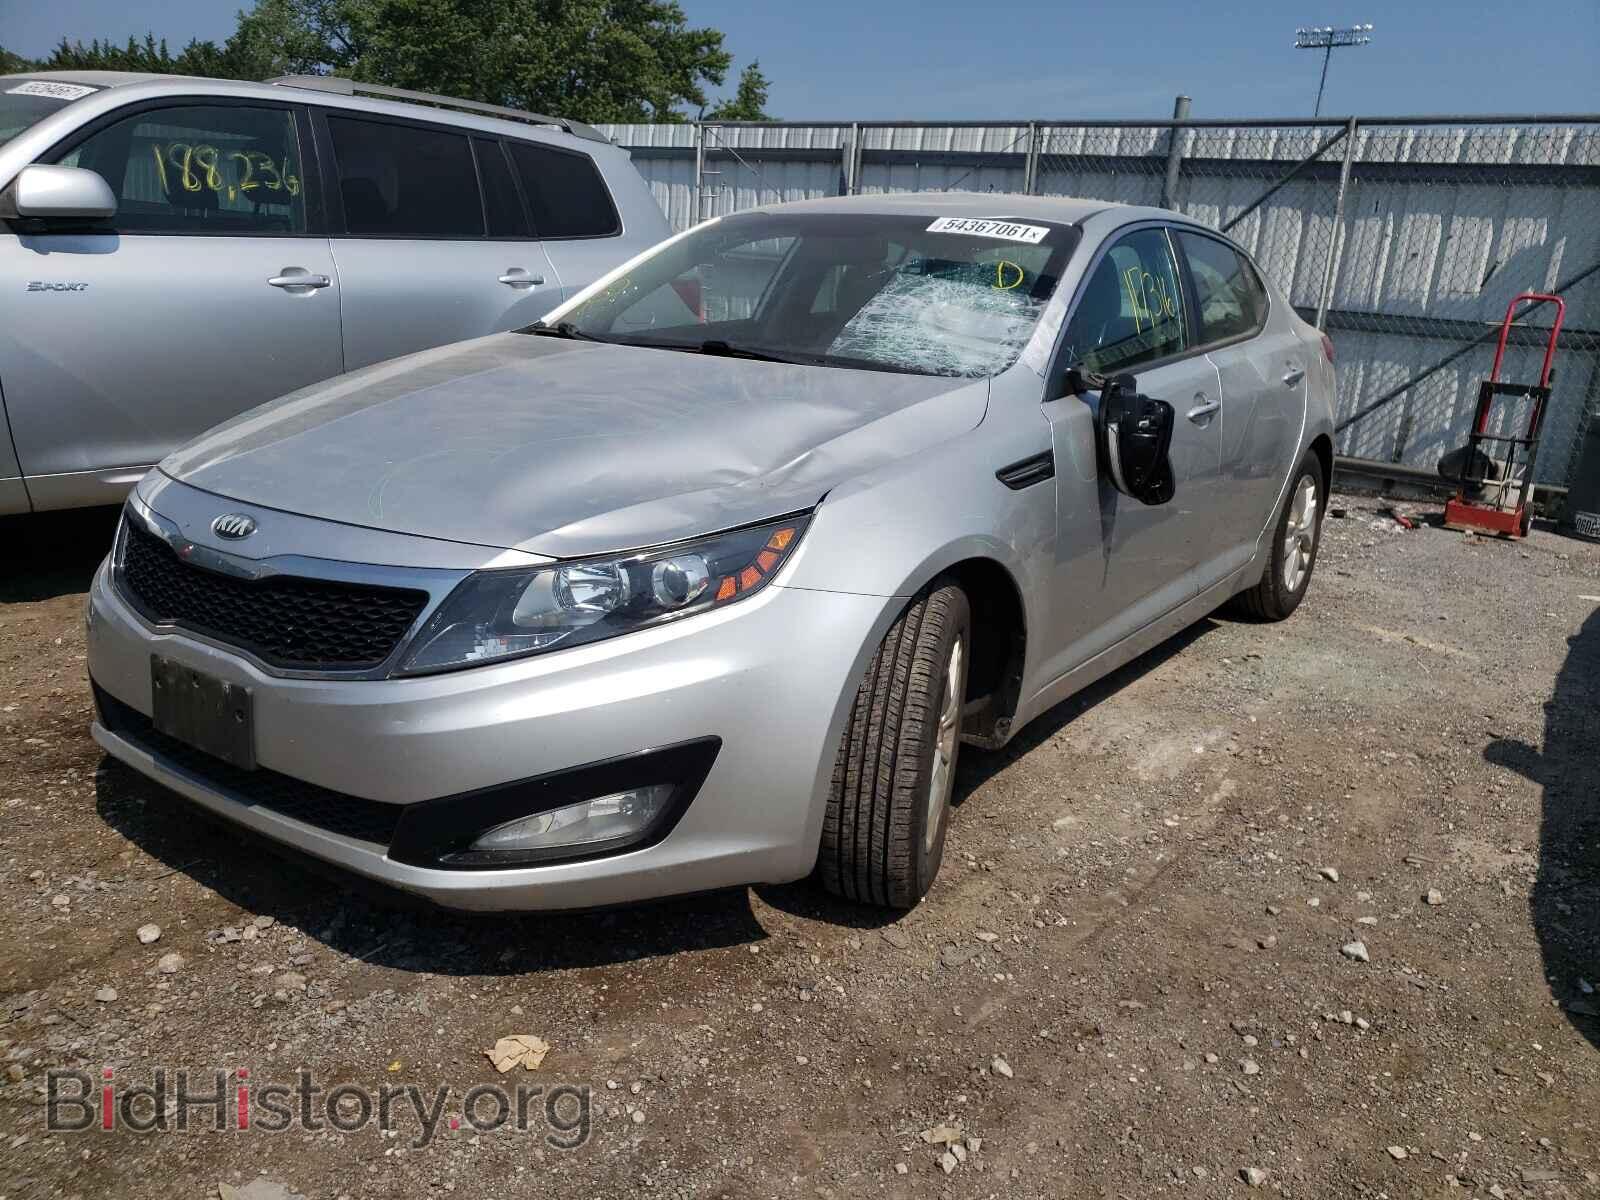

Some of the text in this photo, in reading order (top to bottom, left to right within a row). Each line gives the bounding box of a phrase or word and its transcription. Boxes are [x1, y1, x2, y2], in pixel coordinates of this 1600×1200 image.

[151, 142, 301, 204] 188,236
[991, 260, 1025, 291] D
[215, 514, 253, 536] KIA
